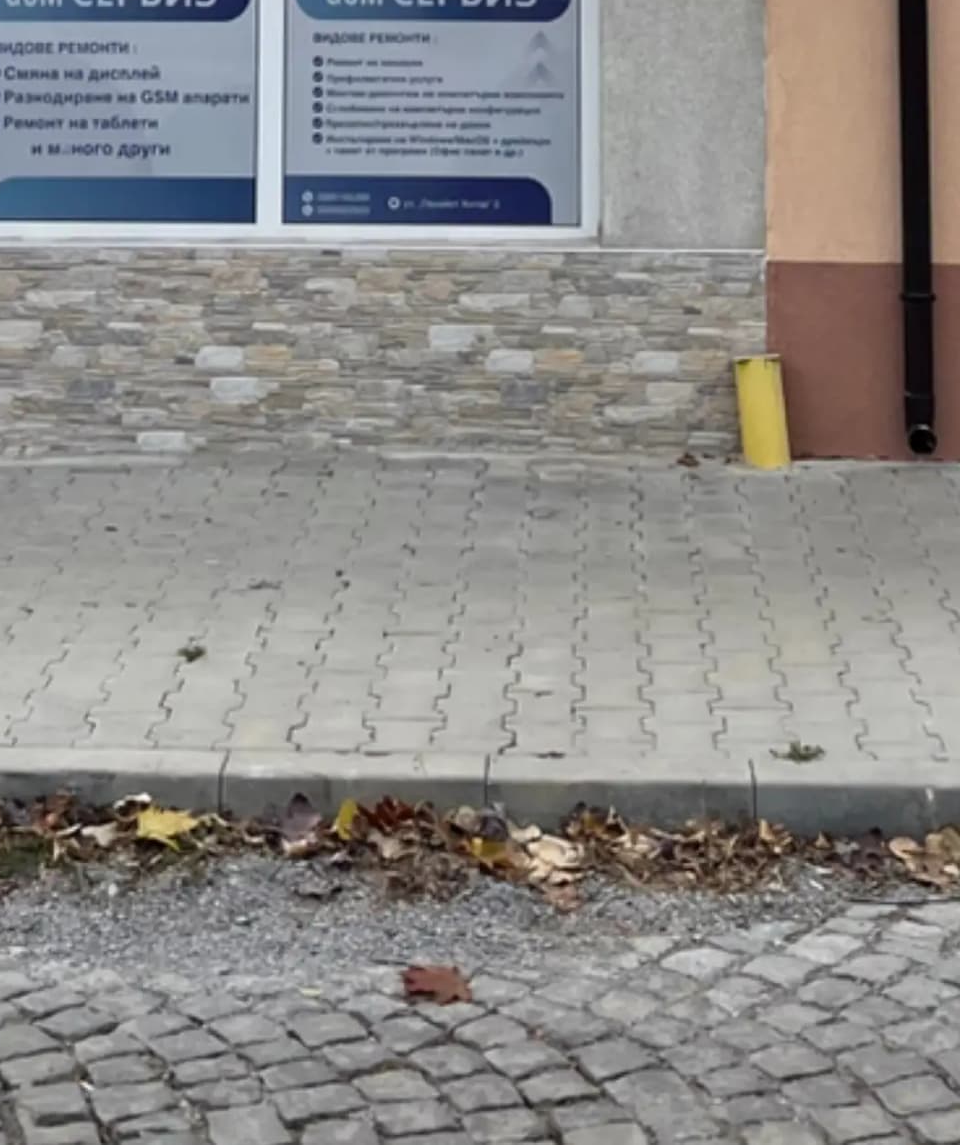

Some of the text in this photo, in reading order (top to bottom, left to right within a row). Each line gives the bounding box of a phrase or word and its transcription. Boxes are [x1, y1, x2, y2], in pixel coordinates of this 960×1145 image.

[57, 41, 130, 55] РЕМОНТИ
[3, 64, 161, 83] Смяна на дисплей
[116, 91, 137, 105] на
[140, 89, 179, 105] GSM
[182, 91, 251, 108] апарати
[3, 114, 159, 130] Ремонт на таблети
[116, 143, 171, 159] други
